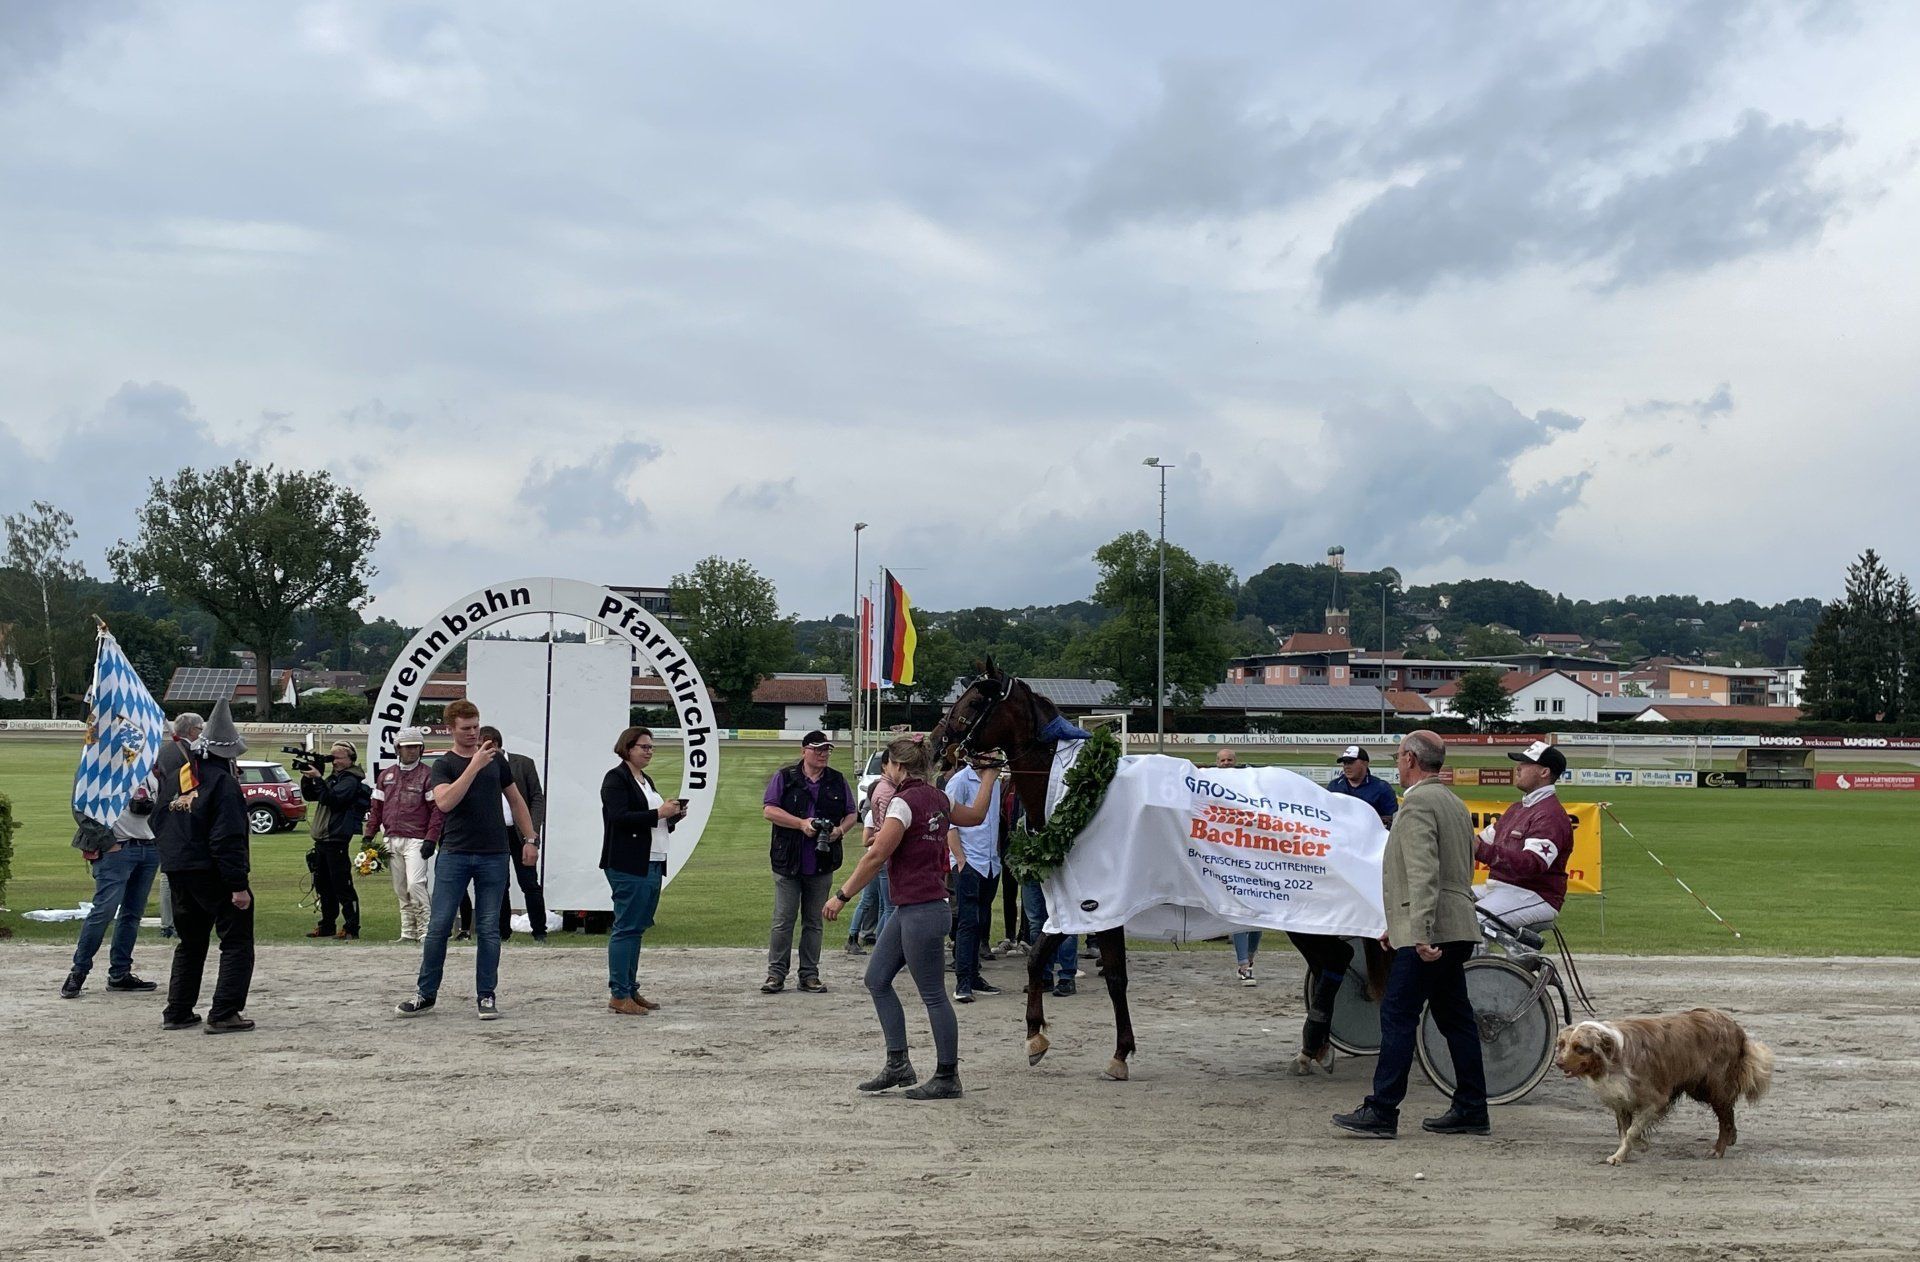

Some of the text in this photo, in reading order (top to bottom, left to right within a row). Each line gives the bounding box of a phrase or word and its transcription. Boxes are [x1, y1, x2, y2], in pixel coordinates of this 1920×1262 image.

[373, 586, 531, 784] Trabrennbahn
[598, 595, 712, 791] Pfarrkirchen
[257, 787, 278, 798] Region
[1278, 801, 1332, 822] PREIS
[1256, 812, 1331, 839] Bäcker
[1190, 818, 1331, 857] Bachmeier
[1254, 861, 1327, 875] ZUCHTRENNEN
[1226, 885, 1290, 902] Pfarrkirchen
[1284, 879, 1314, 891] 2022
